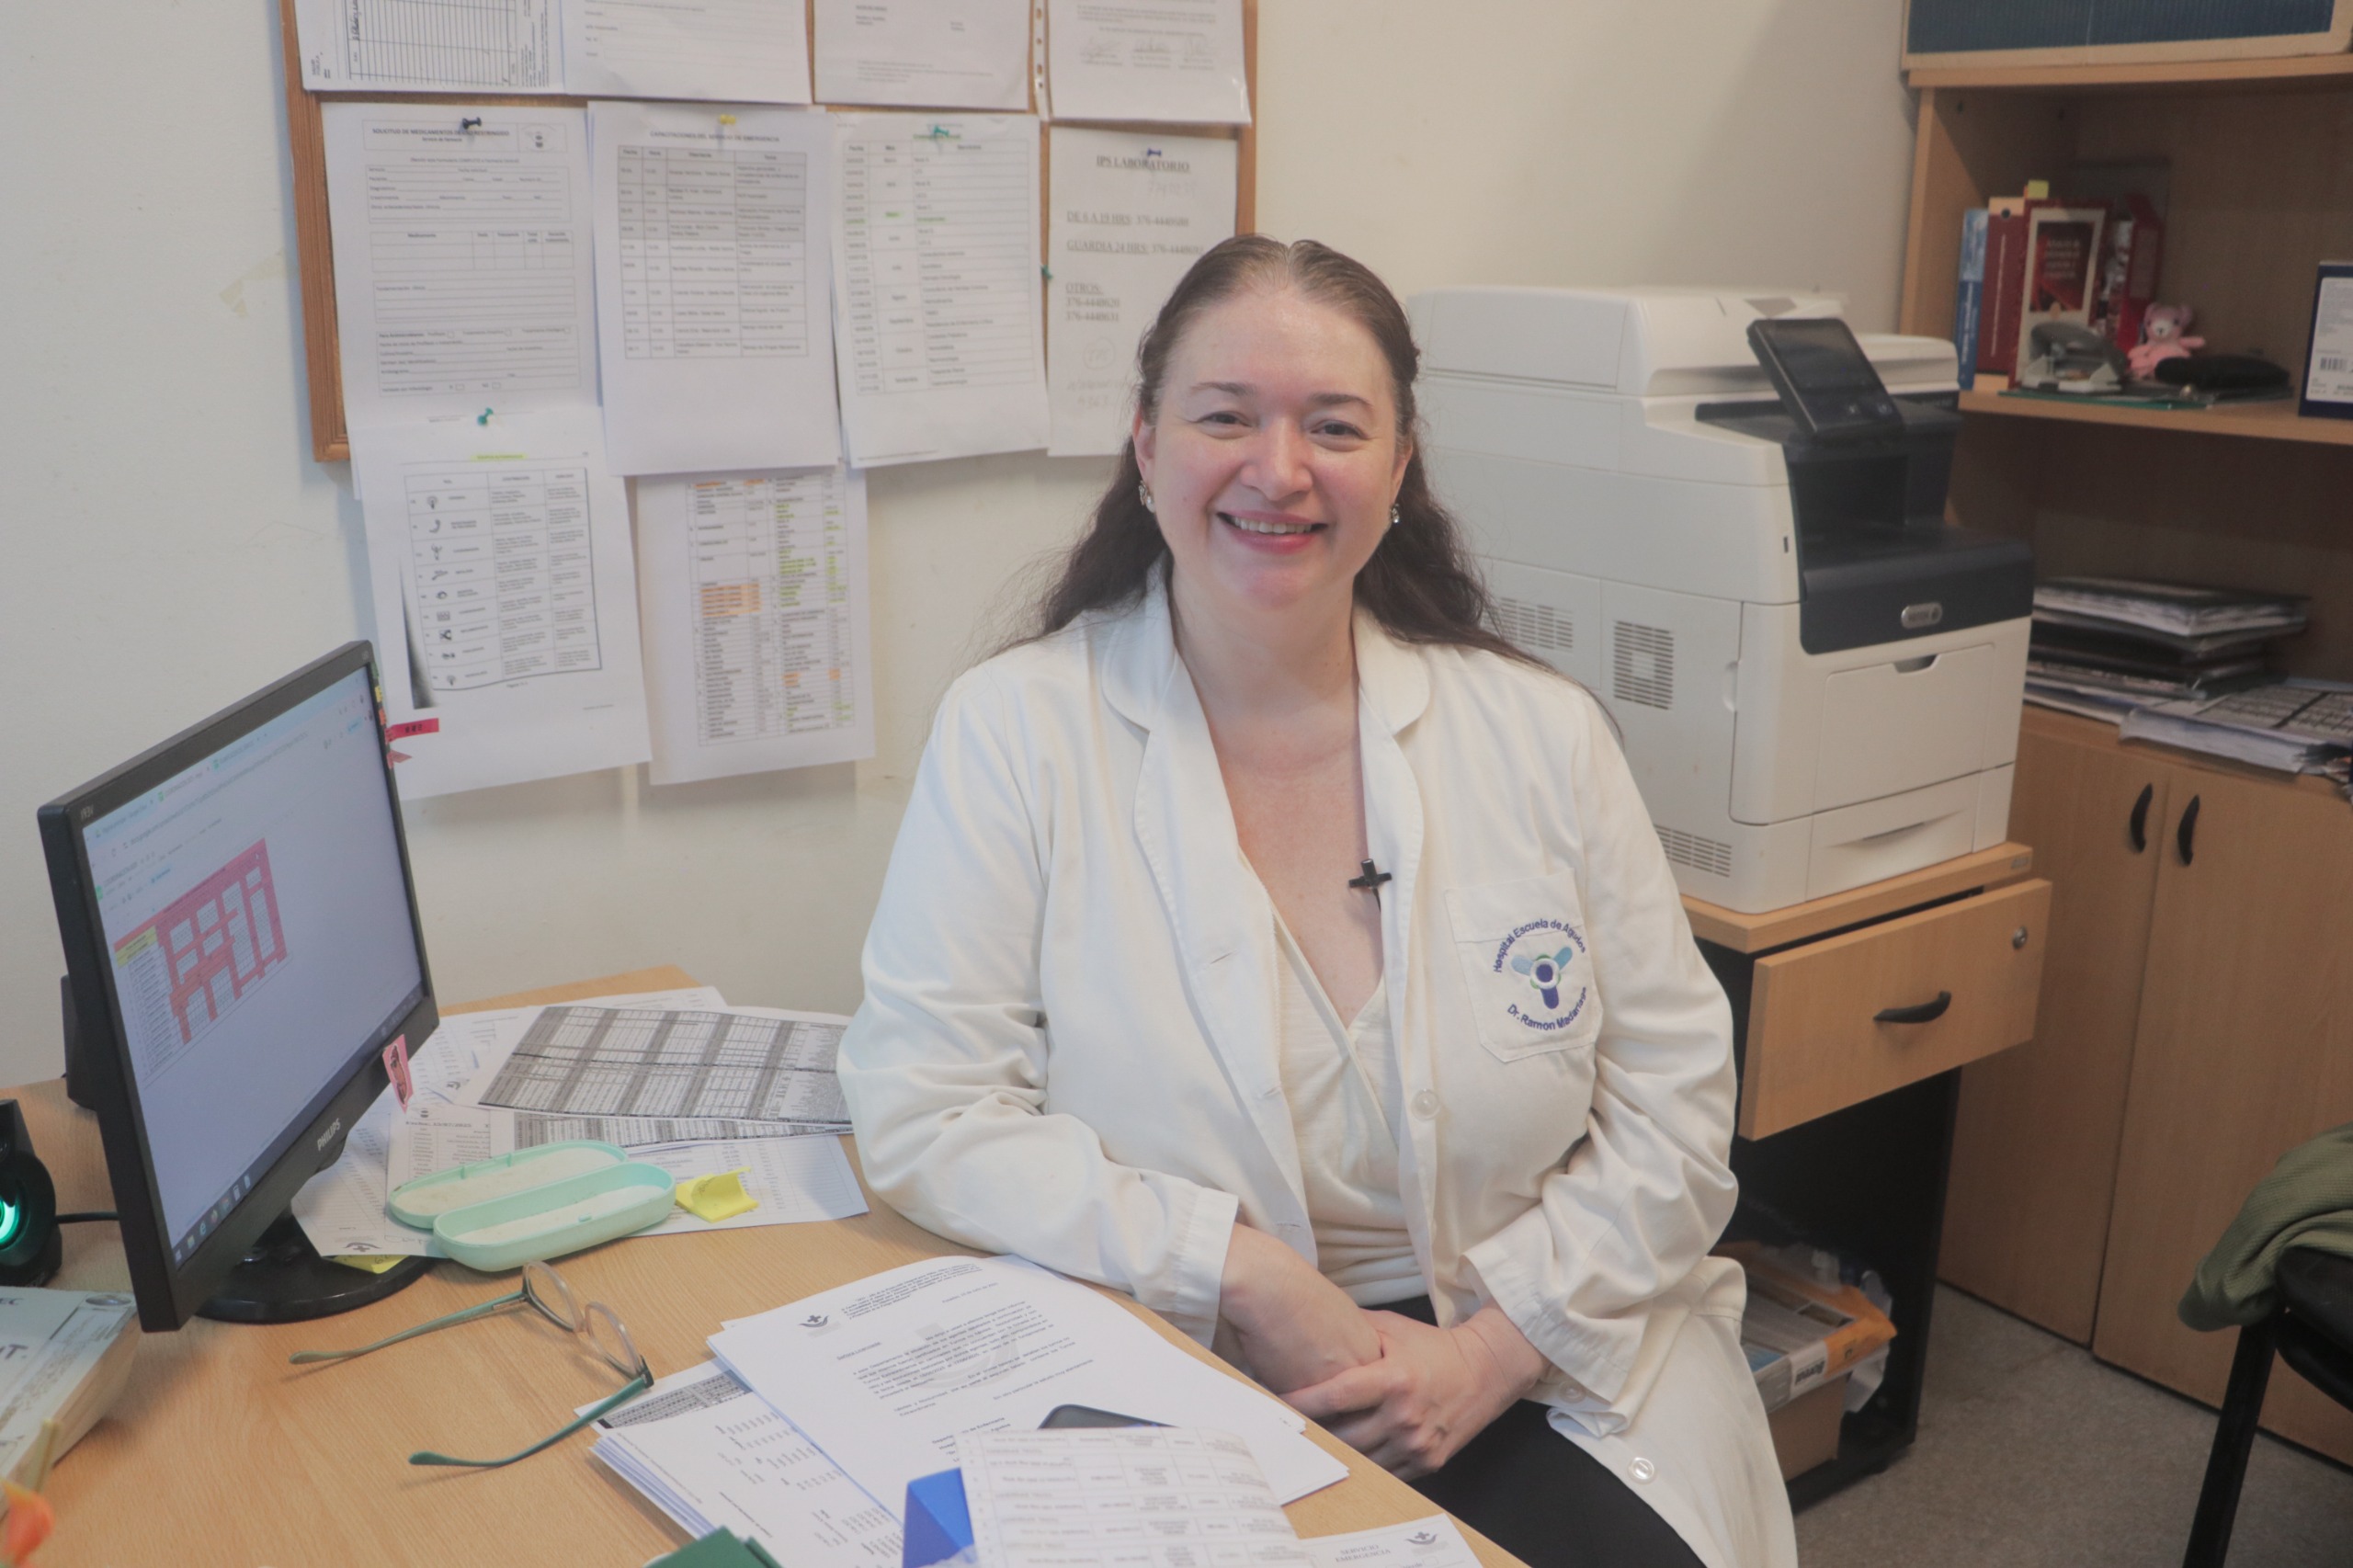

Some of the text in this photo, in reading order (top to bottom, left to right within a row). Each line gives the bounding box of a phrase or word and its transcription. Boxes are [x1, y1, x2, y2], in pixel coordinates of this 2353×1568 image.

[1096, 154, 1190, 173] IPS LABORATORIO
[1066, 210, 1080, 223] DE
[1066, 239, 1113, 253] GUARDIA
[1493, 919, 1586, 973] Hospital Escuela de Agudos
[1507, 1004, 1520, 1020] Dr.
[316, 1118, 341, 1151] PHILIPS
[1334, 1548, 1392, 1563] EMERGENCIA
[1339, 1542, 1380, 1556] SERVICIO
